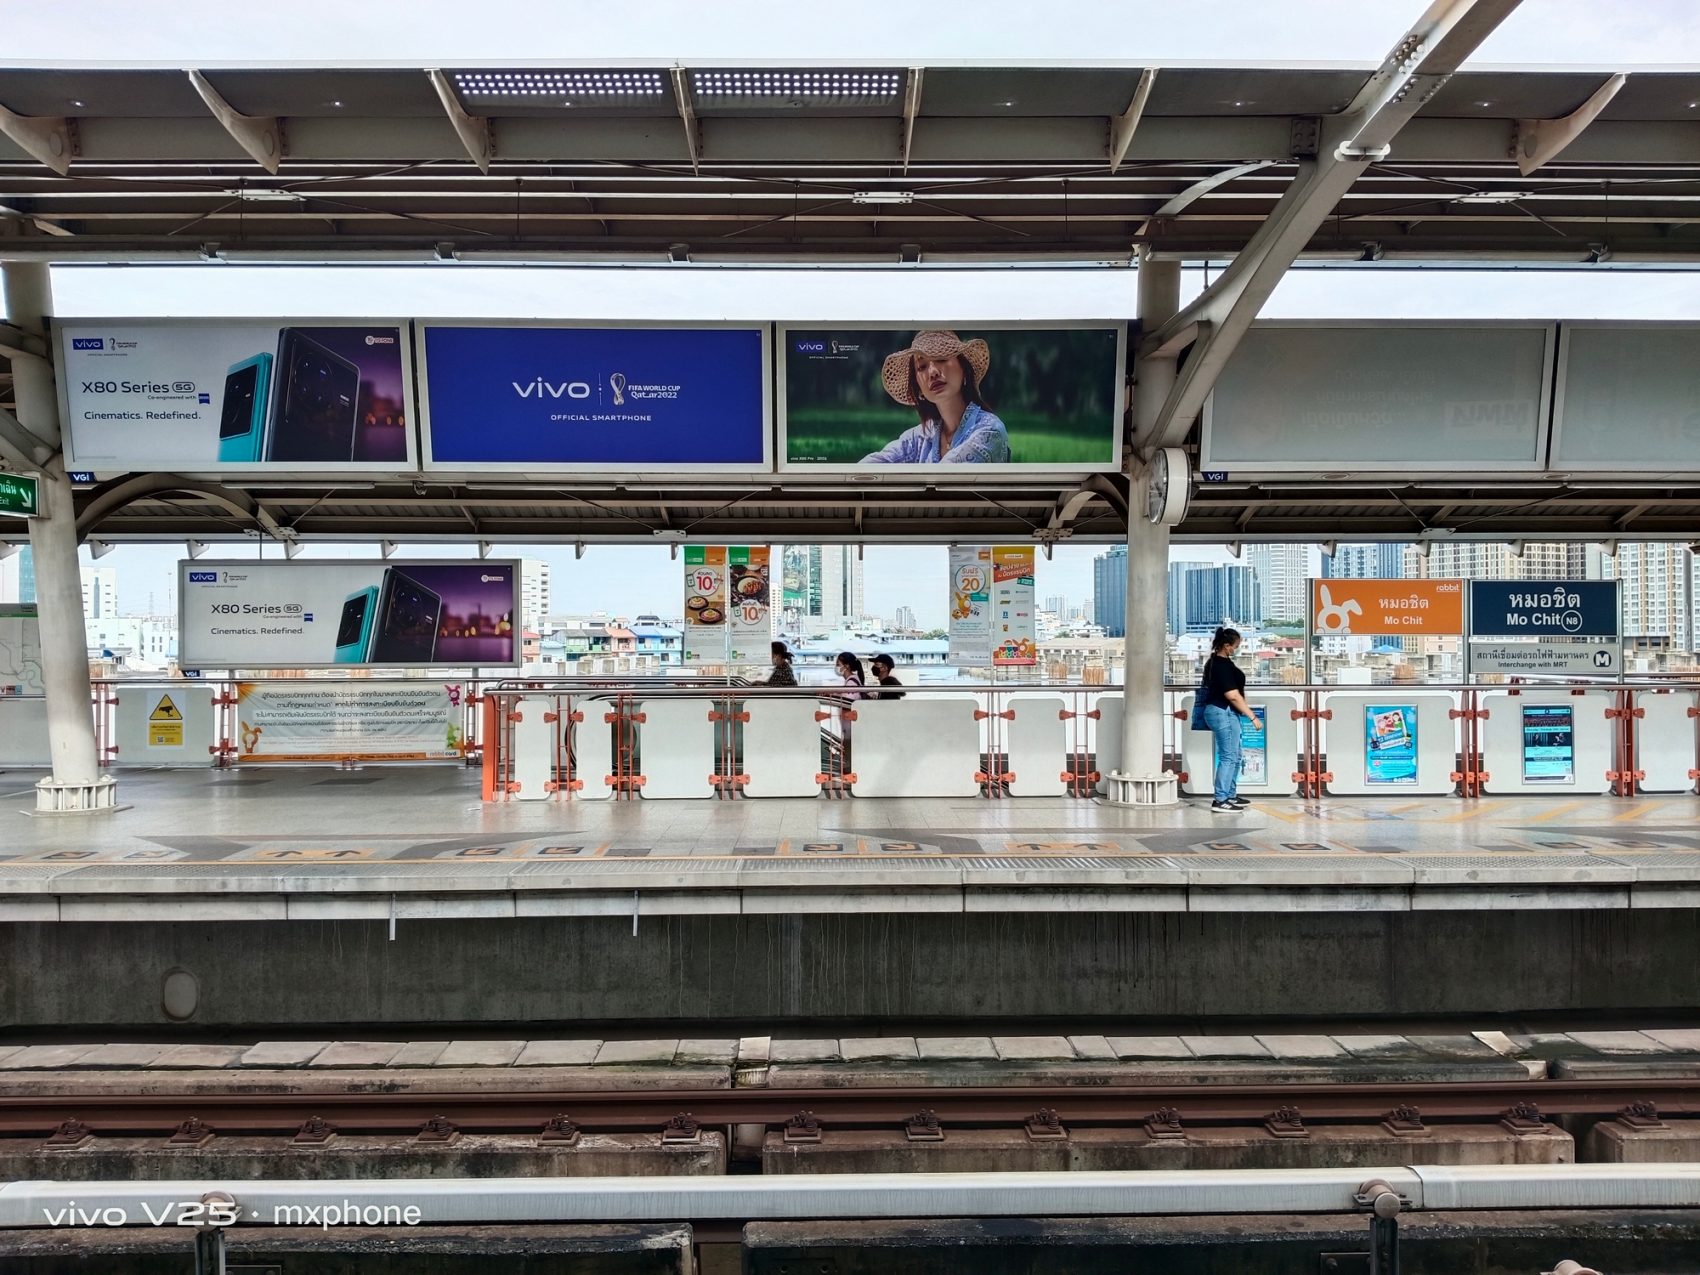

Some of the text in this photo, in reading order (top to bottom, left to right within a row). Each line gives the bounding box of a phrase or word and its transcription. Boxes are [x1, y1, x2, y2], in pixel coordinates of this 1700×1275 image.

[76, 340, 101, 348] vivo
[799, 343, 823, 351] vivo
[82, 381, 117, 393] X80
[121, 381, 169, 393] Series
[512, 376, 591, 399] vivo
[84, 411, 201, 420] Cinematics. Redefined.
[192, 573, 214, 581] vivo
[1436, 584, 1460, 592] rabbit
[1379, 594, 1429, 609] หมอชิต
[1509, 587, 1580, 608] หมอชิต
[211, 604, 240, 613] X80
[243, 604, 281, 613] Series
[1384, 616, 1423, 624] Mo Chit
[1507, 613, 1578, 625] Mo Chit N8
[1477, 647, 1589, 660] สถานีเชื่อมต่อรถไฟฟ้ามหานคร
